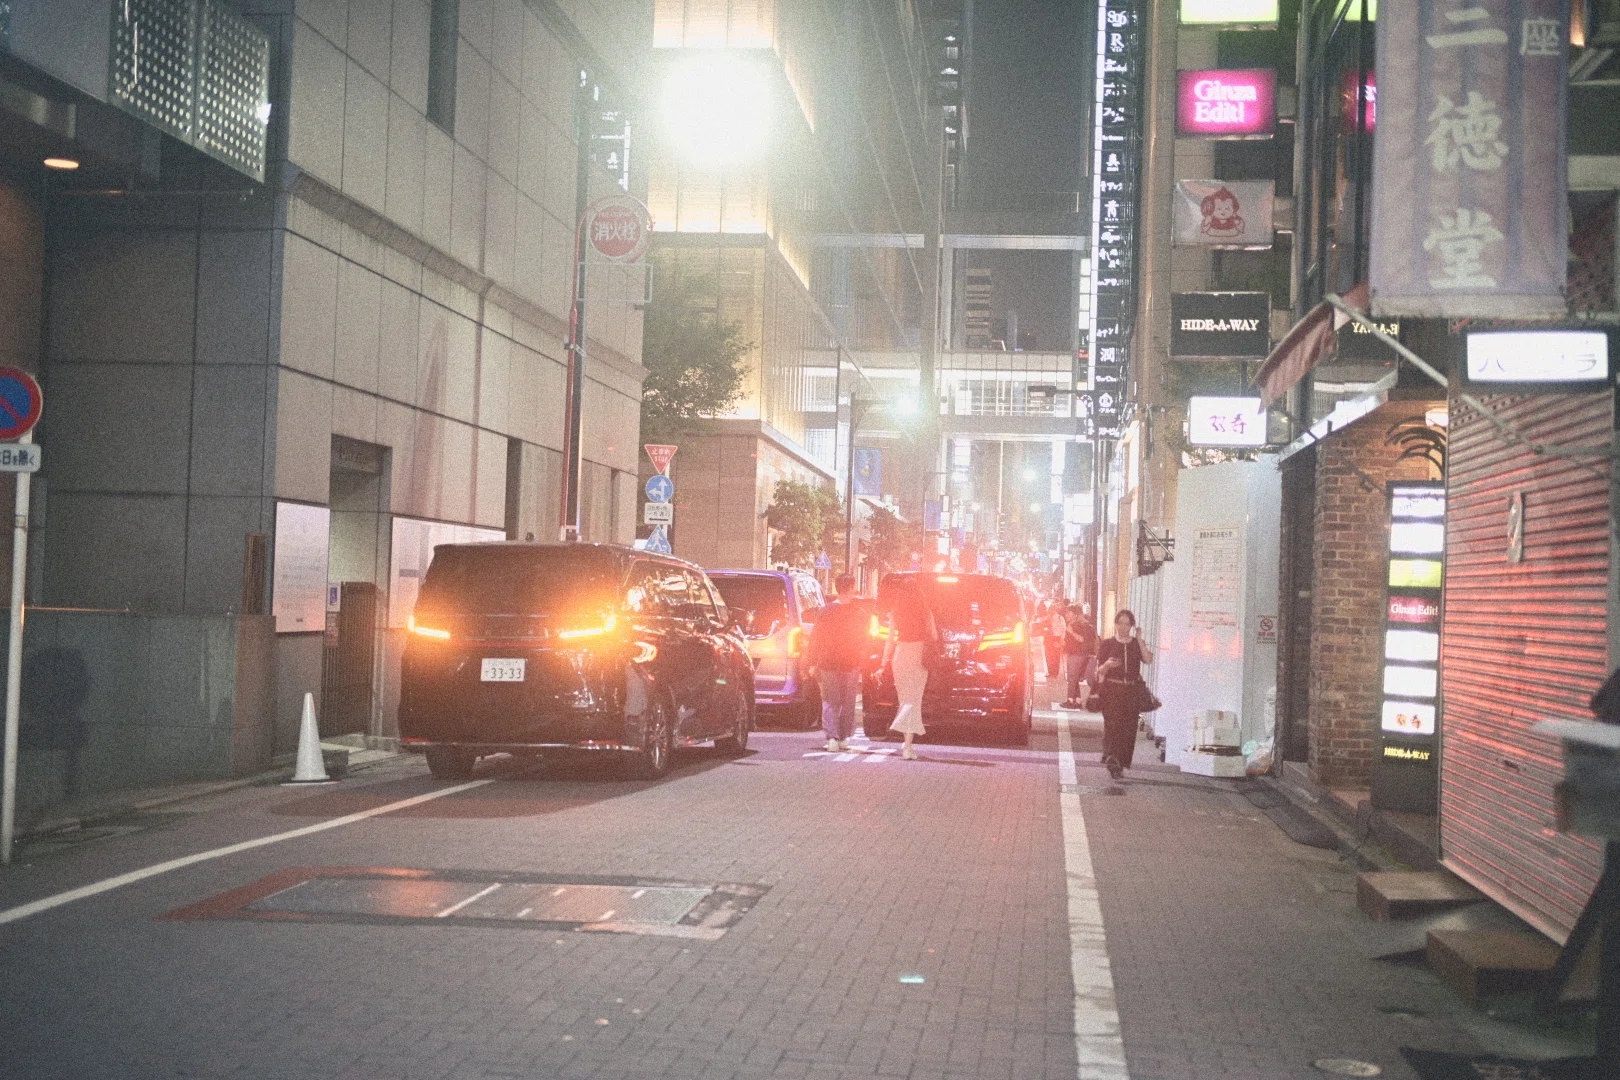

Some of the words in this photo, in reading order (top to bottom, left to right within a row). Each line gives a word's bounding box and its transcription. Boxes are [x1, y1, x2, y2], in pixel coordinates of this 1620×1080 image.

[1521, 16, 1560, 55] 座
[1194, 80, 1257, 101] Ginza
[595, 220, 637, 241] 消火栓
[0, 449, 35, 466] 日を除く
[1390, 603, 1416, 615] Ginza
[1418, 604, 1438, 616] Edit!
[490, 667, 522, 679] 33-33
